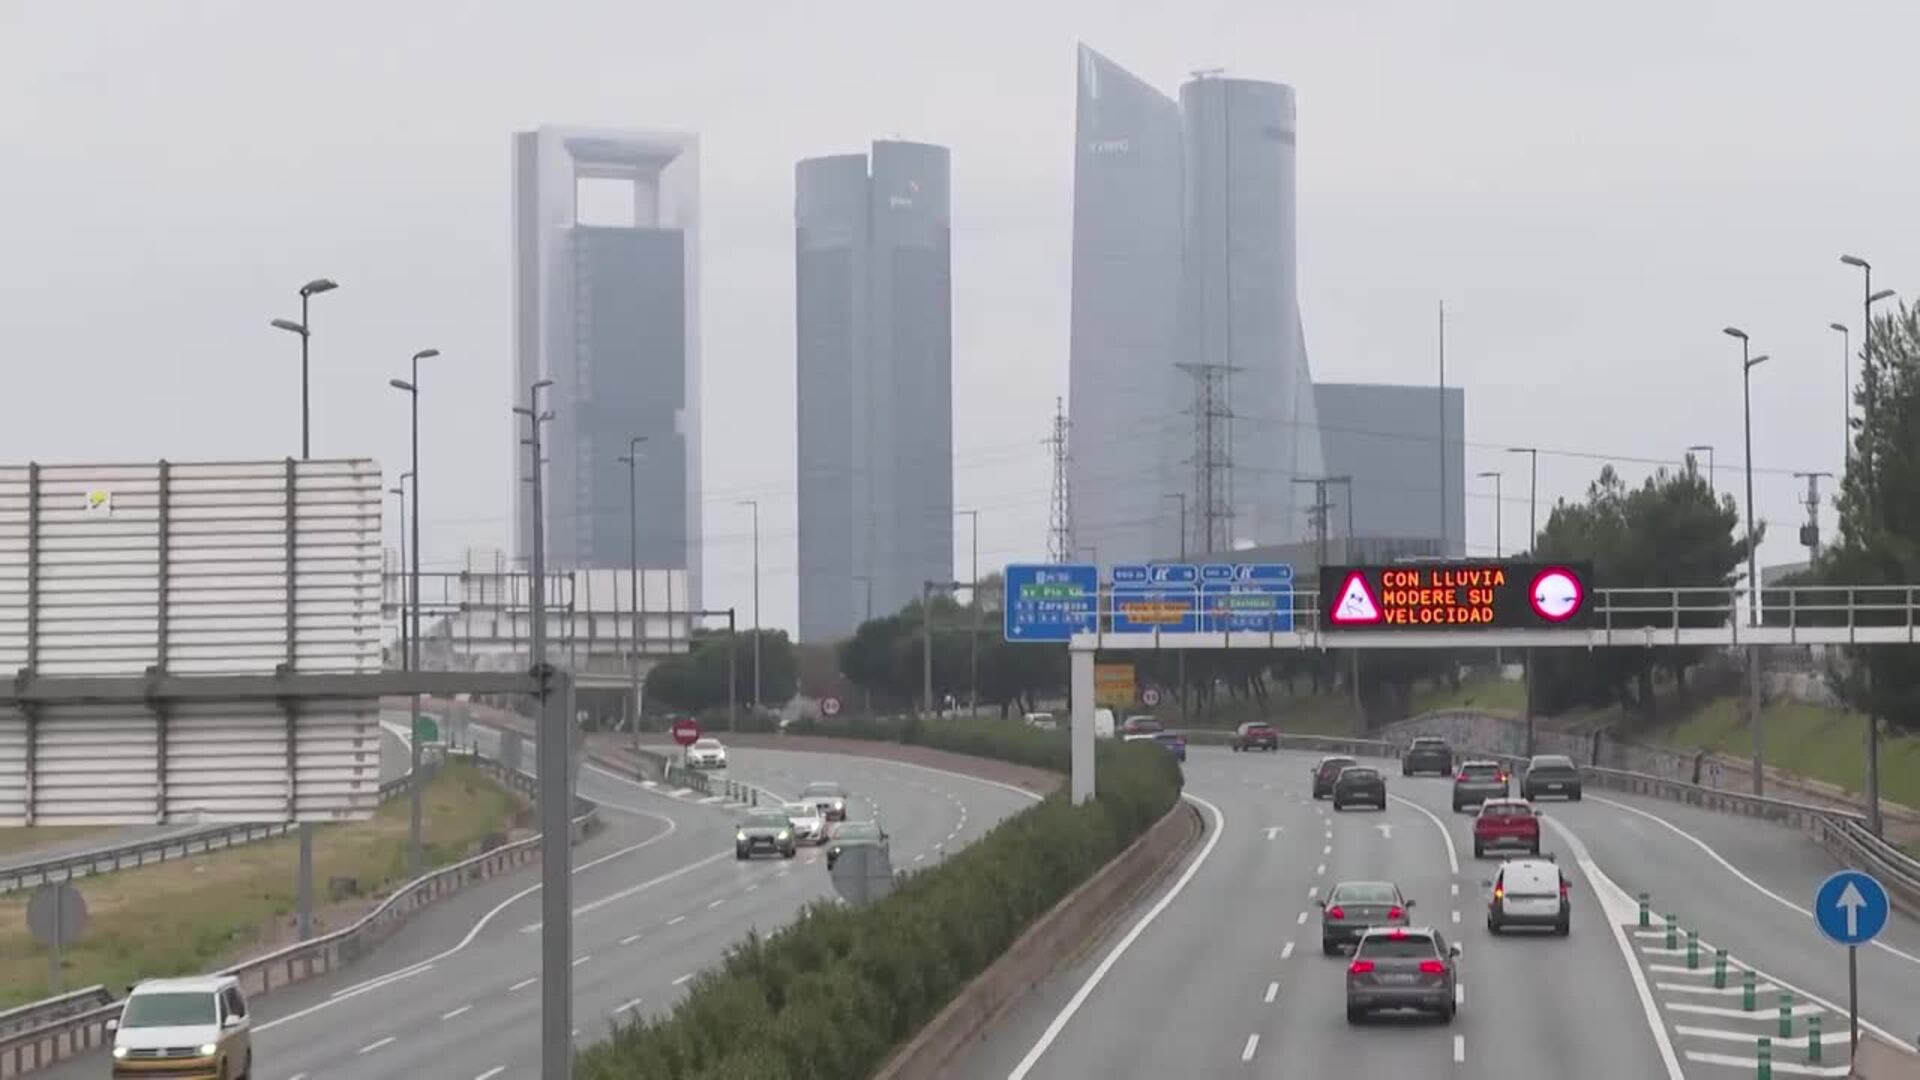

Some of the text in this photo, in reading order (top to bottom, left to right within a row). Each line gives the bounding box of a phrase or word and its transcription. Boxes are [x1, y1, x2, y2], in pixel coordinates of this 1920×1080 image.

[1383, 571, 1505, 587] CON LLUVIA
[1383, 588, 1494, 605] MODERE SU
[1383, 607, 1494, 623] VELOCIDAD
